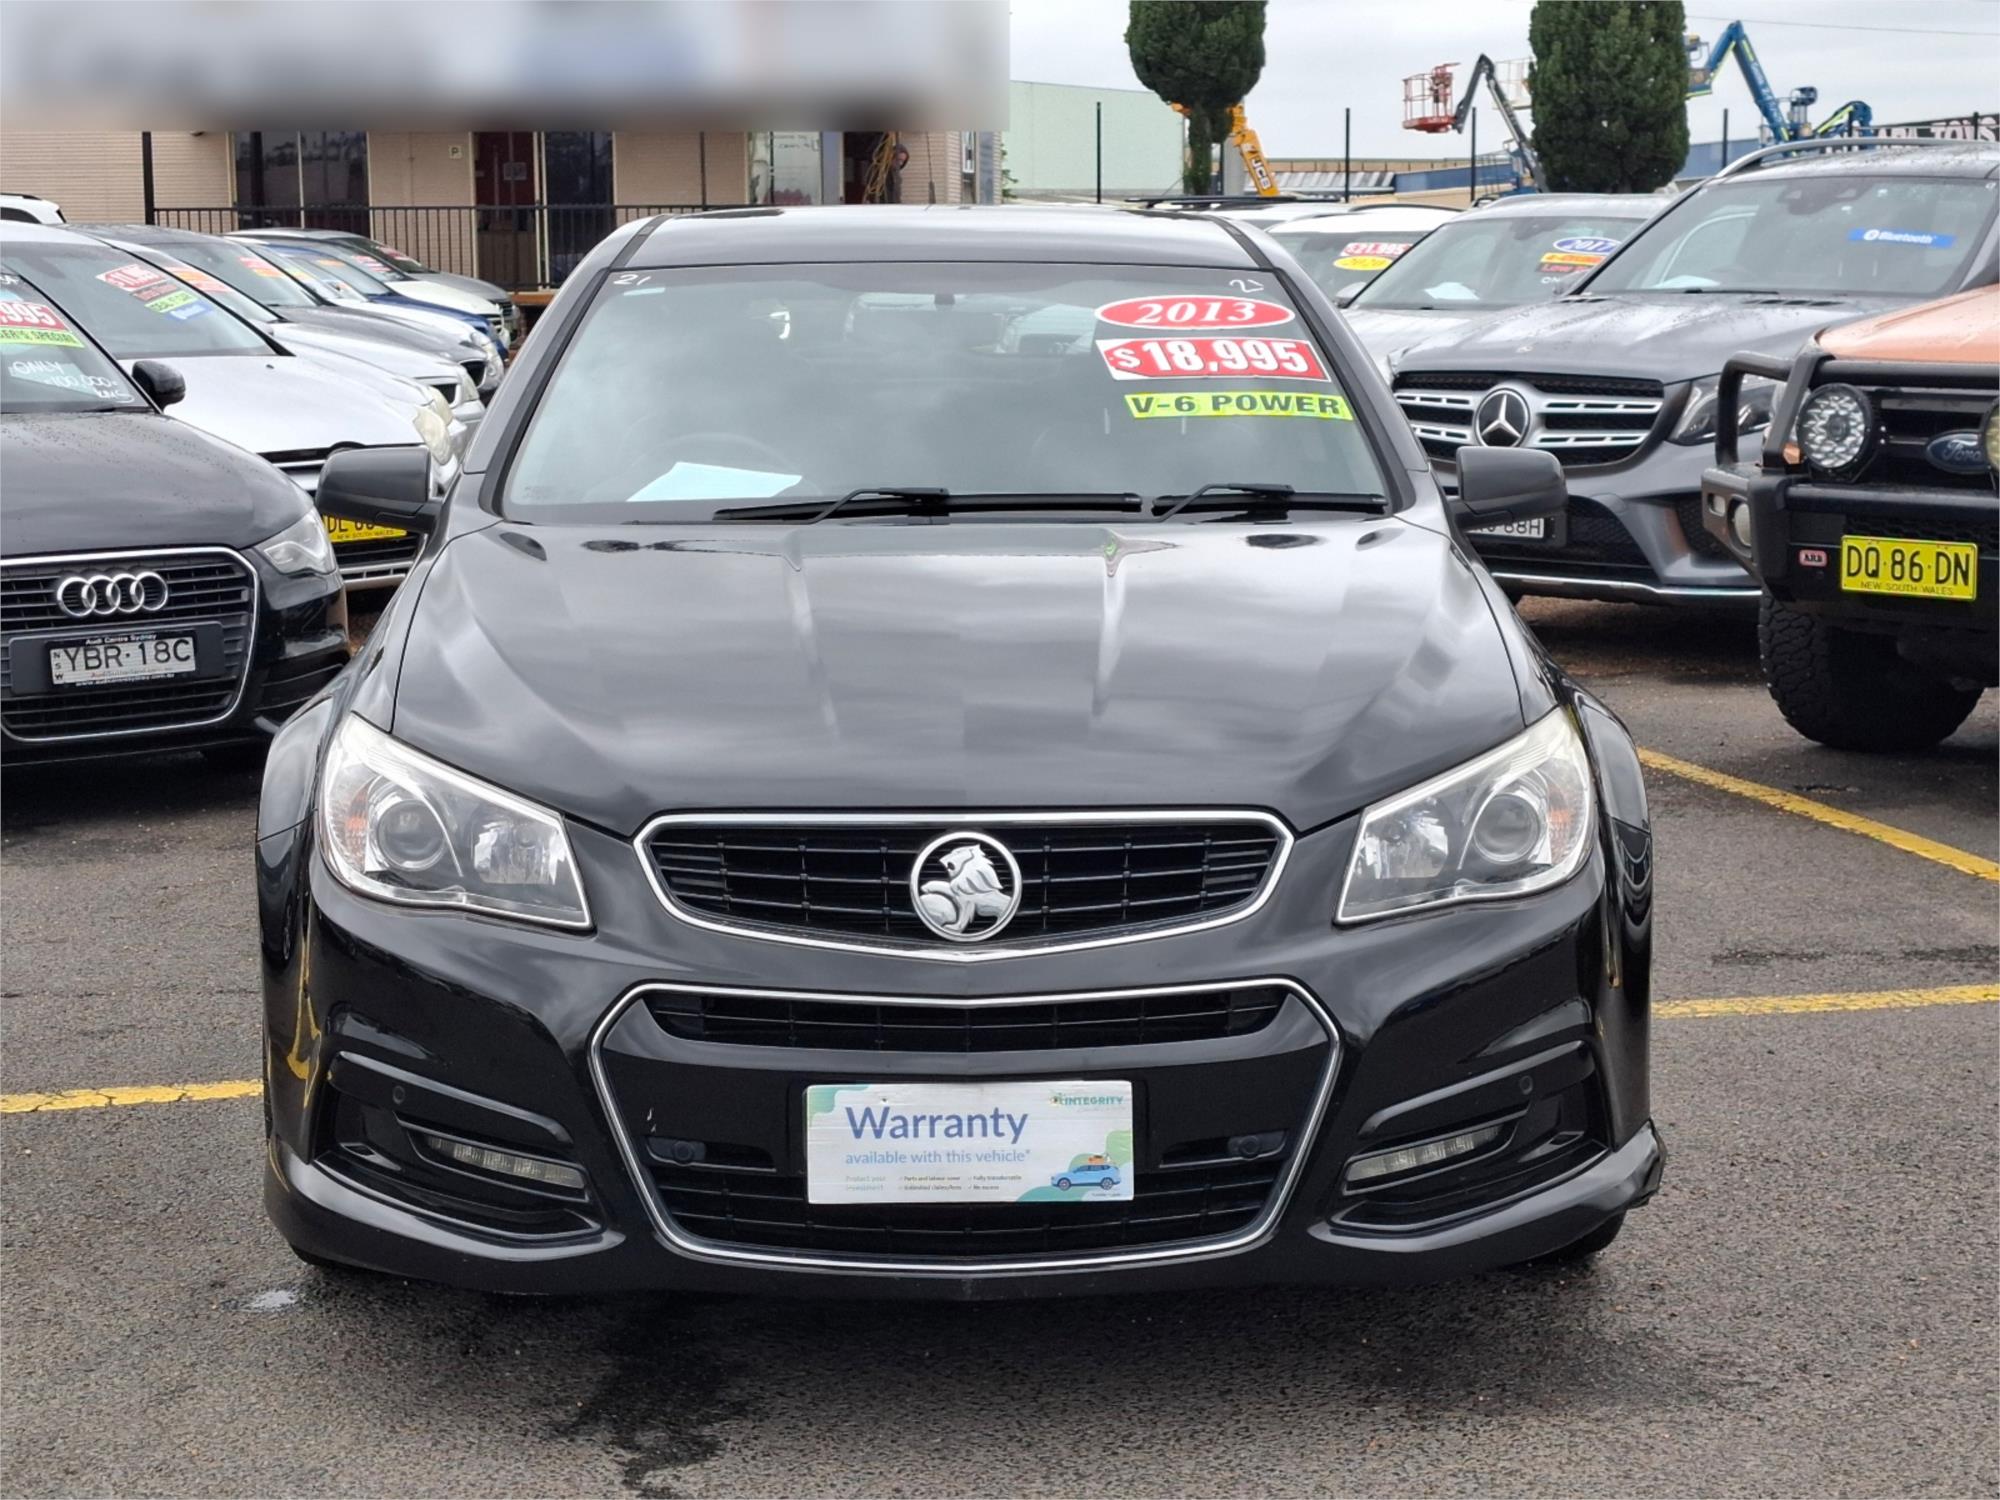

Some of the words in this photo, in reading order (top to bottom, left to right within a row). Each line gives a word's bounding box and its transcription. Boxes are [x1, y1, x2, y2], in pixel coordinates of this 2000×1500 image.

[1251, 158, 1272, 190] JCB
[1134, 301, 1256, 324] 2013
[1113, 339, 1308, 373] $18,995
[1131, 395, 1196, 413] V-6
[1211, 394, 1341, 415] POWER
[1803, 552, 1823, 564] ARB
[1860, 581, 1882, 590] NEW
[1885, 583, 1918, 592] SOUTH
[1921, 585, 1954, 596] WALES
[130, 633, 158, 641] Sydney
[1064, 1095, 1124, 1106] INTEGRITY
[845, 1105, 1029, 1145] Warranty
[845, 1150, 908, 1165] available
[910, 1150, 943, 1164] with
[946, 1149, 973, 1163] this
